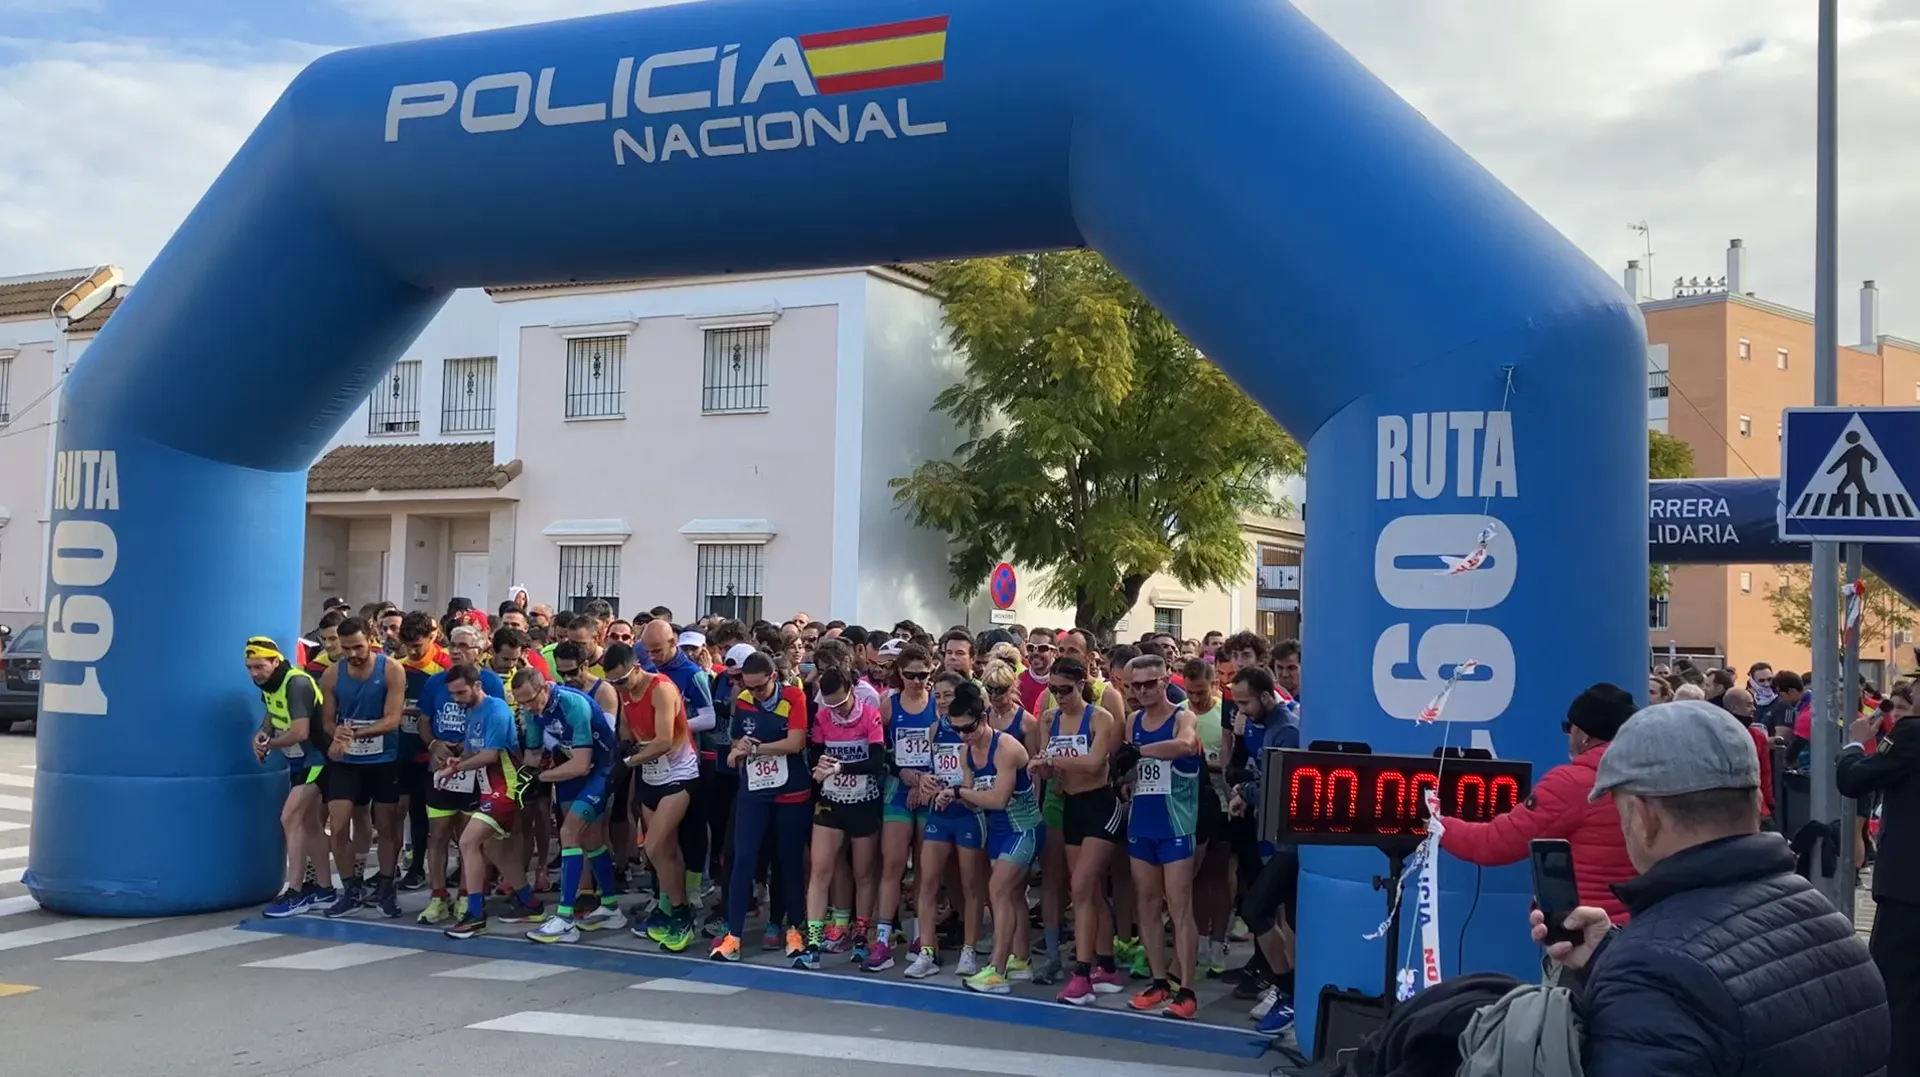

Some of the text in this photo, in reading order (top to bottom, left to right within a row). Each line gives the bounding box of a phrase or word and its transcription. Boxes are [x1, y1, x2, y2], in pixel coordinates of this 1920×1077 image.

[613, 98, 947, 166] NACIONAL
[1376, 411, 1519, 500] RUTA
[54, 450, 120, 511] RUTA
[1649, 498, 1731, 518] RRERA
[42, 520, 118, 716] 091
[1371, 514, 1518, 760] 09
[905, 739, 930, 754] 312
[755, 760, 779, 777] 364
[937, 755, 958, 770] 360
[1138, 764, 1161, 781] 198
[833, 772, 857, 788] 528
[1424, 948, 1438, 982] NO
